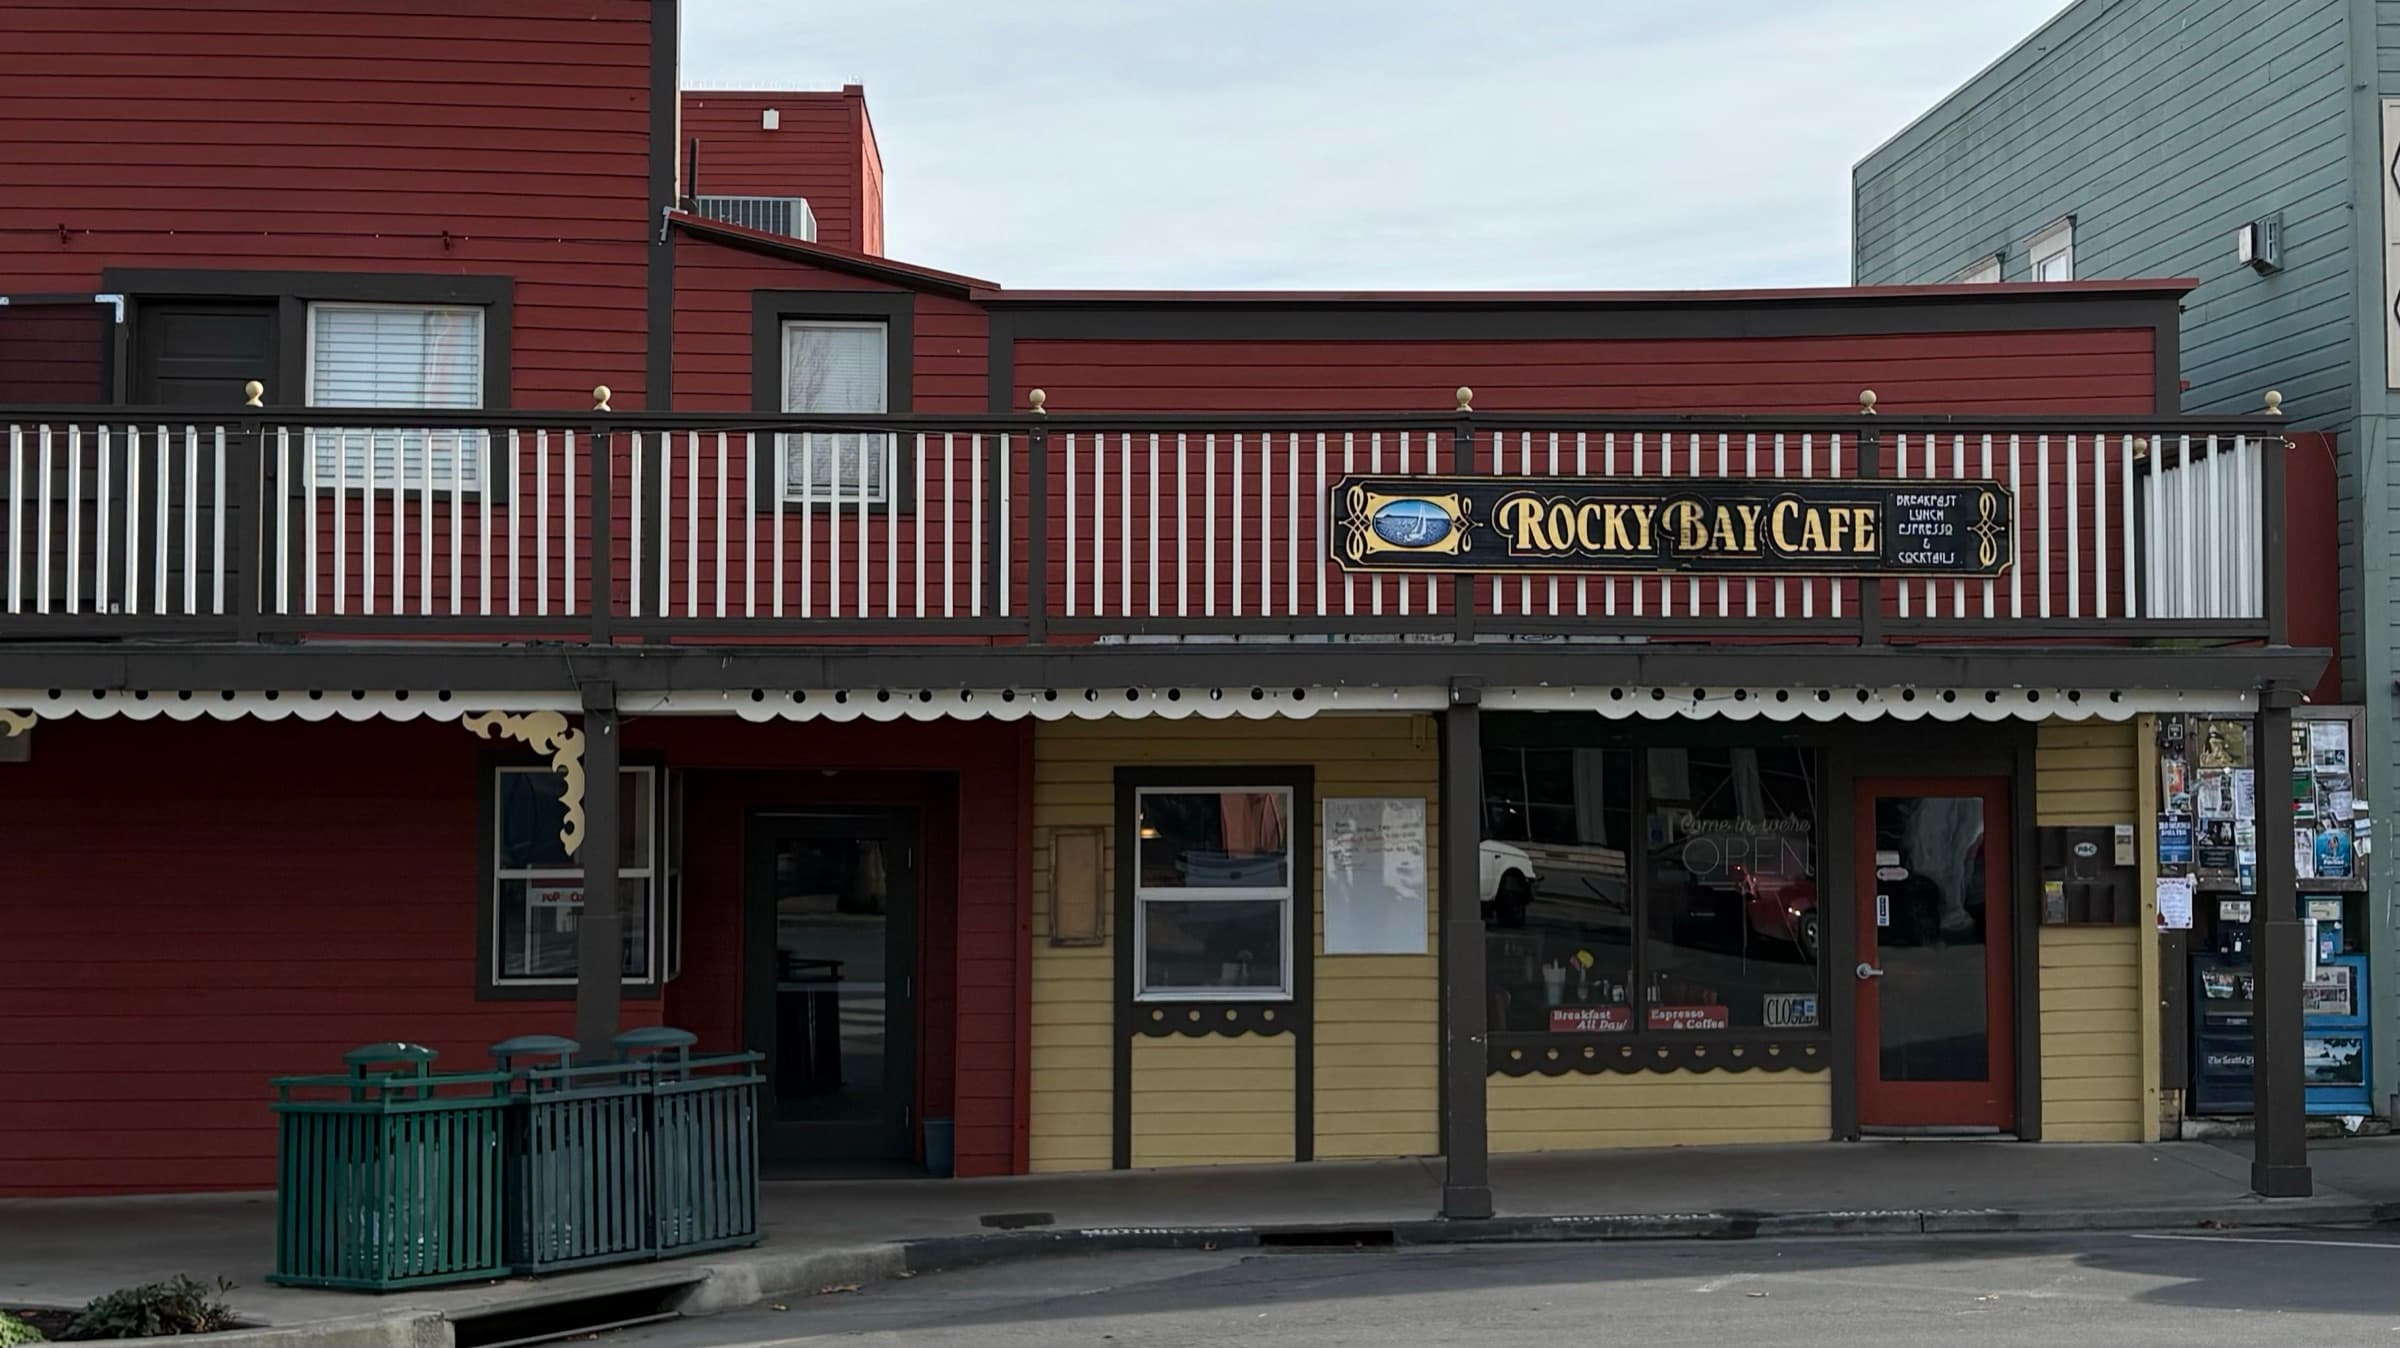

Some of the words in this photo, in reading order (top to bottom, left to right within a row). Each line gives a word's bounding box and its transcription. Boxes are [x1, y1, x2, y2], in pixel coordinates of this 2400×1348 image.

[1896, 495, 1957, 507] BREAKFAST
[1909, 508, 1944, 521] LUNCH
[1499, 498, 1657, 551] ROCKY
[1661, 499, 1762, 551] BAY
[1771, 499, 1875, 552] CAFE
[1898, 523, 1953, 536] ESPRESSO
[1898, 551, 1955, 564] COCKTAILS
[1680, 811, 1732, 834] Come
[1682, 836, 1815, 877] OPEN
[1553, 1009, 1611, 1020] Breakfast
[1650, 1009, 1704, 1021] Espresso
[1577, 1020, 1596, 1031] All
[1686, 1019, 1725, 1029] Coffee
